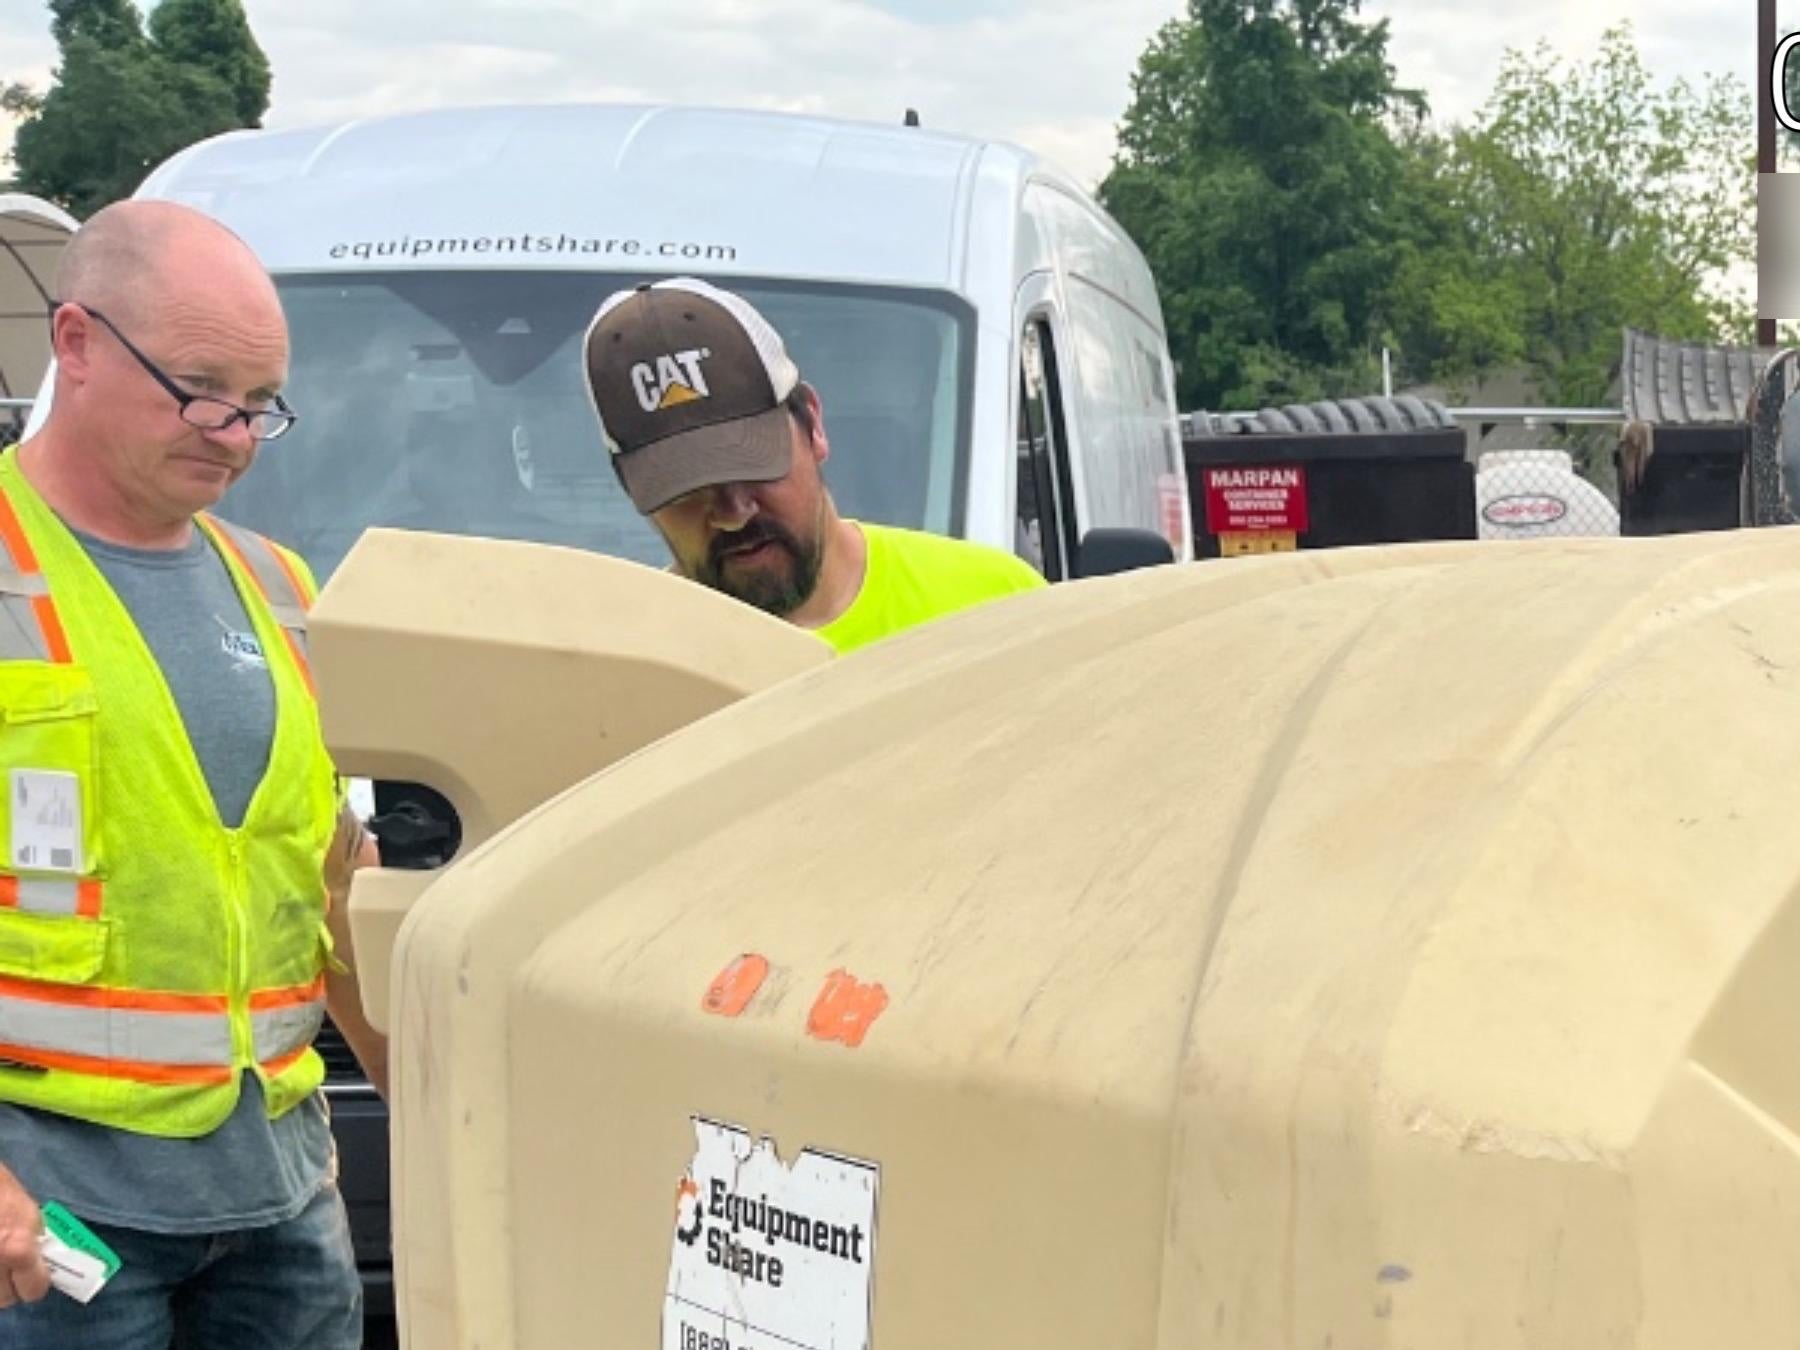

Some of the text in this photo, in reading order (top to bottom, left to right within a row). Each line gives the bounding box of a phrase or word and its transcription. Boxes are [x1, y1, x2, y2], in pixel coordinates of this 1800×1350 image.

[329, 233, 738, 260] equipmentshare.com
[631, 350, 710, 412] CAT
[1211, 468, 1299, 488] MARPAN
[708, 1178, 864, 1264] Equipment
[707, 1225, 784, 1288] Share
